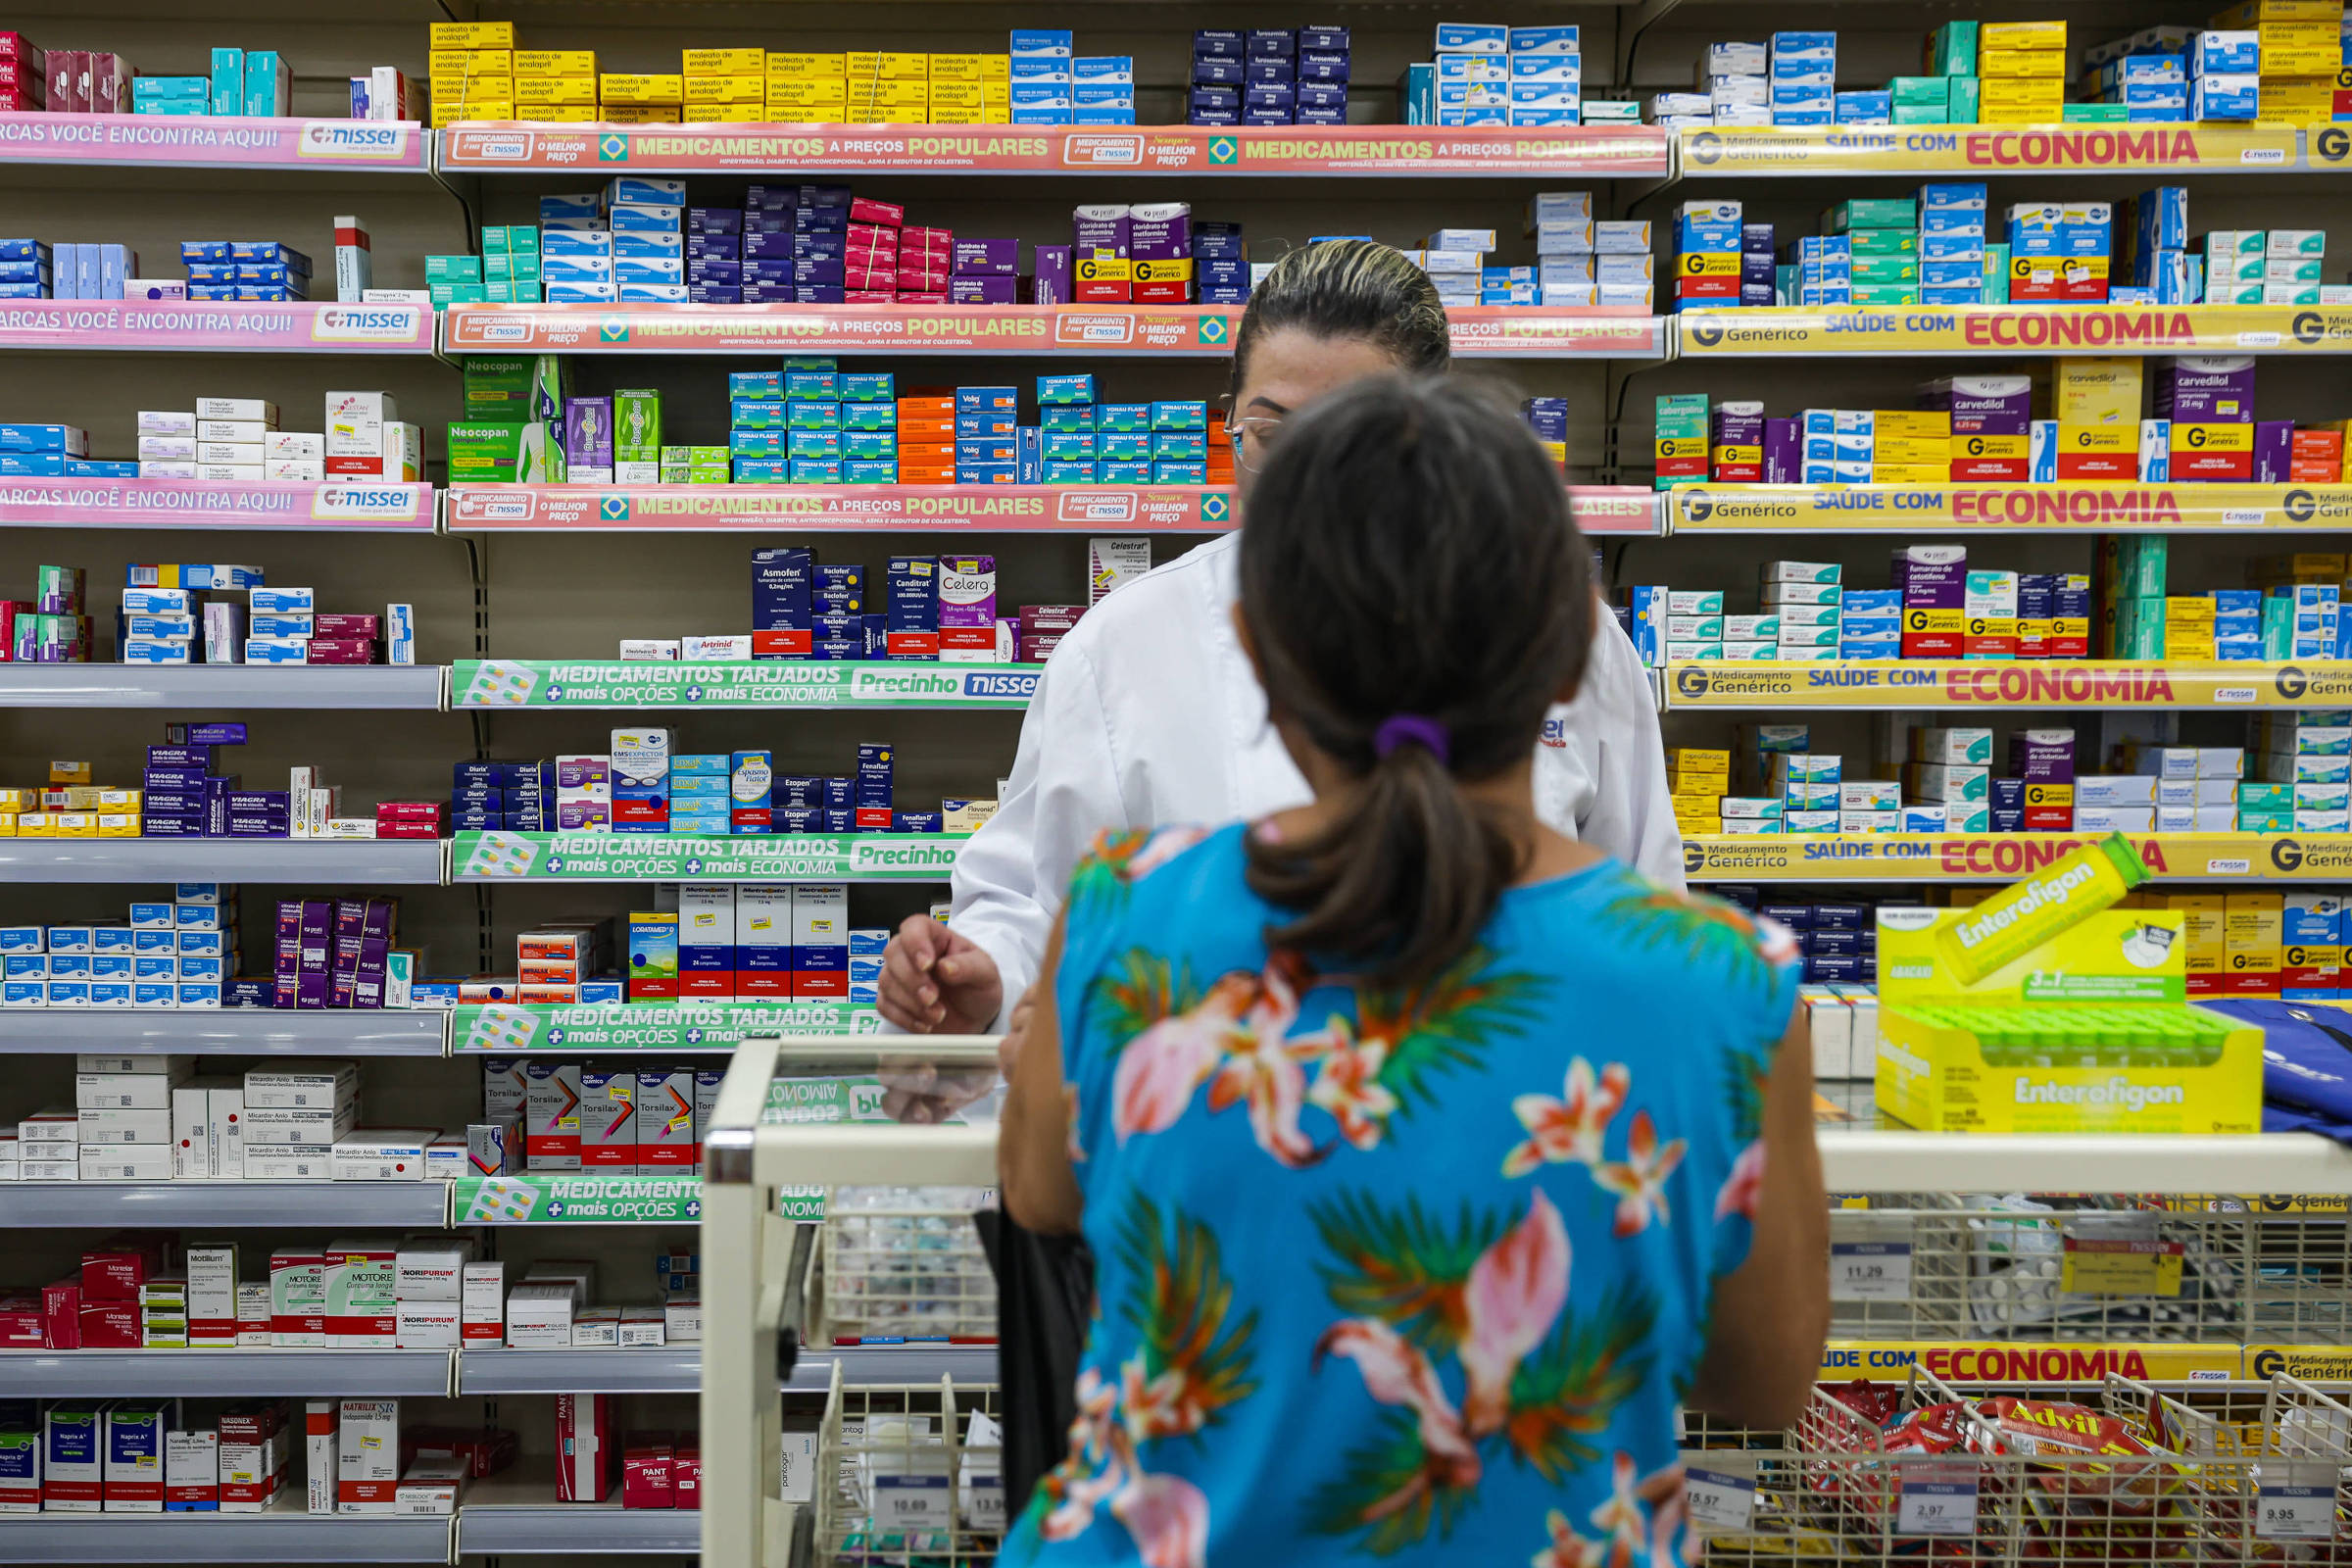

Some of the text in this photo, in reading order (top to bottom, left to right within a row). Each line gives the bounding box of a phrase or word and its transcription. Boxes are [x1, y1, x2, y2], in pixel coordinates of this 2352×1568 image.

[52, 121, 103, 142] VOCÊ
[110, 125, 217, 146] ENCONTRA
[221, 127, 279, 147] AQUI!
[334, 125, 396, 146] nissei
[547, 143, 586, 152] MELHOR
[636, 137, 1048, 156] MEDICAMENTOS A PREÇOS POPULARES
[2318, 128, 2351, 161] G
[547, 152, 577, 163] PREÇO
[1156, 156, 1187, 166] PREÇO
[66, 309, 119, 328] VOCÊ
[124, 313, 232, 329] ENCONTRA
[238, 314, 292, 330] AQUI!
[346, 313, 410, 328] nissei
[637, 318, 1046, 336] MEDICAMENTOS A PREÇOS POPULARES
[2292, 312, 2325, 343] G
[549, 333, 578, 344] PREÇO
[1728, 328, 1807, 341] Genérico
[467, 362, 522, 371] Neocopan
[2179, 375, 2229, 386] carvedilol
[1660, 406, 1704, 416] cabergolina
[1955, 399, 2004, 410] carvedilol
[1726, 416, 1762, 425] cabergolina
[452, 427, 509, 438] Neocopan
[69, 488, 120, 508] VOCÊ
[125, 490, 231, 509] ENCONTRA
[237, 491, 292, 510] AQUI!
[346, 491, 409, 507] nissei
[540, 502, 587, 512] O MELHOR
[637, 498, 1044, 514] MEDICAMENTOS A PREÇOS POPULARES
[1813, 489, 2181, 523] SAÚDE COM ECONOMIA
[2283, 490, 2315, 521] G
[1717, 504, 1796, 517] Genérico
[1110, 541, 1145, 550] Celestrat
[763, 568, 799, 577] Asmofen
[943, 576, 989, 594] Celerg
[701, 640, 732, 649] Artrinid
[549, 666, 840, 683] MEDICAMENTOS TARJADOS
[860, 673, 957, 693] Precinho
[1712, 671, 1791, 681] Medicamento
[1809, 664, 2174, 702] SAÚDE COM ECONOMIA
[566, 684, 838, 705] mais OPÇÕES mais ECONOMIA
[1712, 682, 1791, 694] Genérico
[549, 838, 839, 857] MEDICAMENTOS TARJADOS
[858, 846, 956, 864] Precinho
[1804, 838, 1931, 859] SAÚDE COM
[1708, 855, 1788, 867] Genérico
[1956, 861, 2094, 950] Enterofigon
[551, 1009, 839, 1025] MEDICAMENTOS TARJADOS
[567, 1029, 746, 1048] mais OPÇÕES mais
[2015, 1077, 2183, 1111] Enterofigon
[567, 1200, 676, 1220] mais OPÇÕES
[1869, 1349, 2148, 1381] COM ECONOMIA
[2009, 1400, 2099, 1437] Advil
